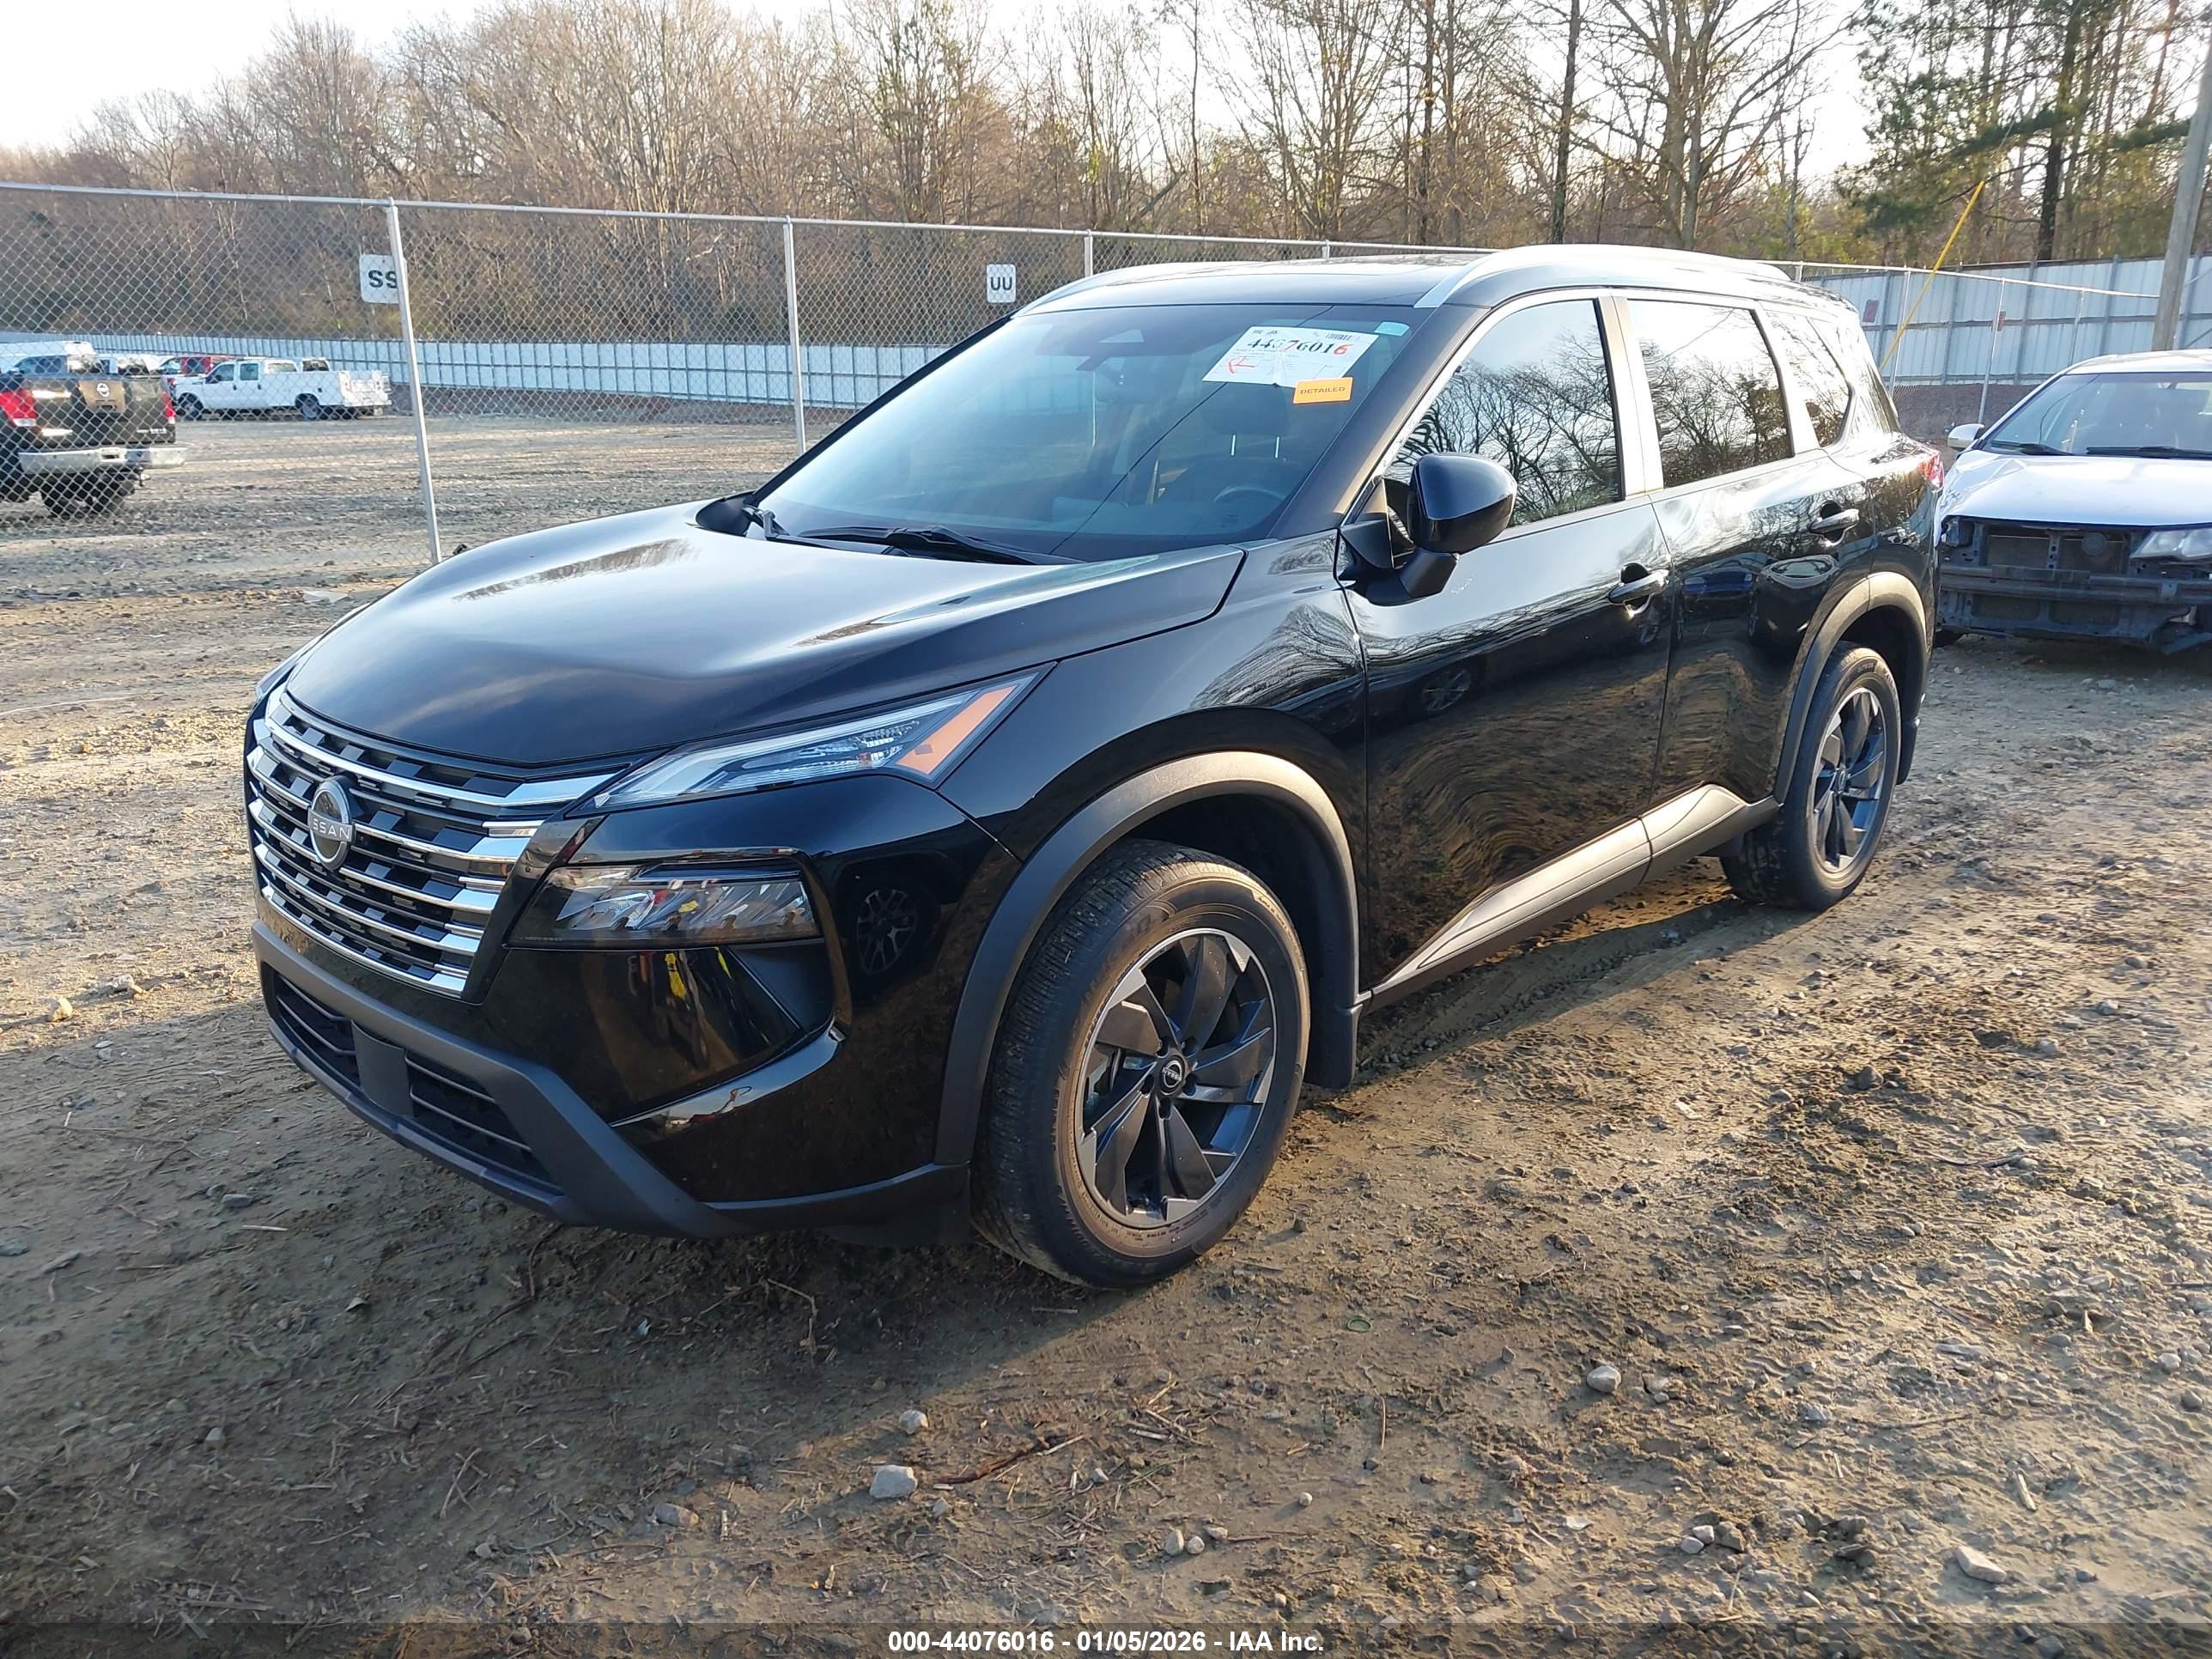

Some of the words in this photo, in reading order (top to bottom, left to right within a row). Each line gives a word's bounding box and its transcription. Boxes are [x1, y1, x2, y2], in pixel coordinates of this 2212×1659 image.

[368, 270, 398, 289] SS
[990, 276, 1012, 290] UU
[1299, 386, 1346, 395] DETAILED
[312, 818, 350, 840] SSAN
